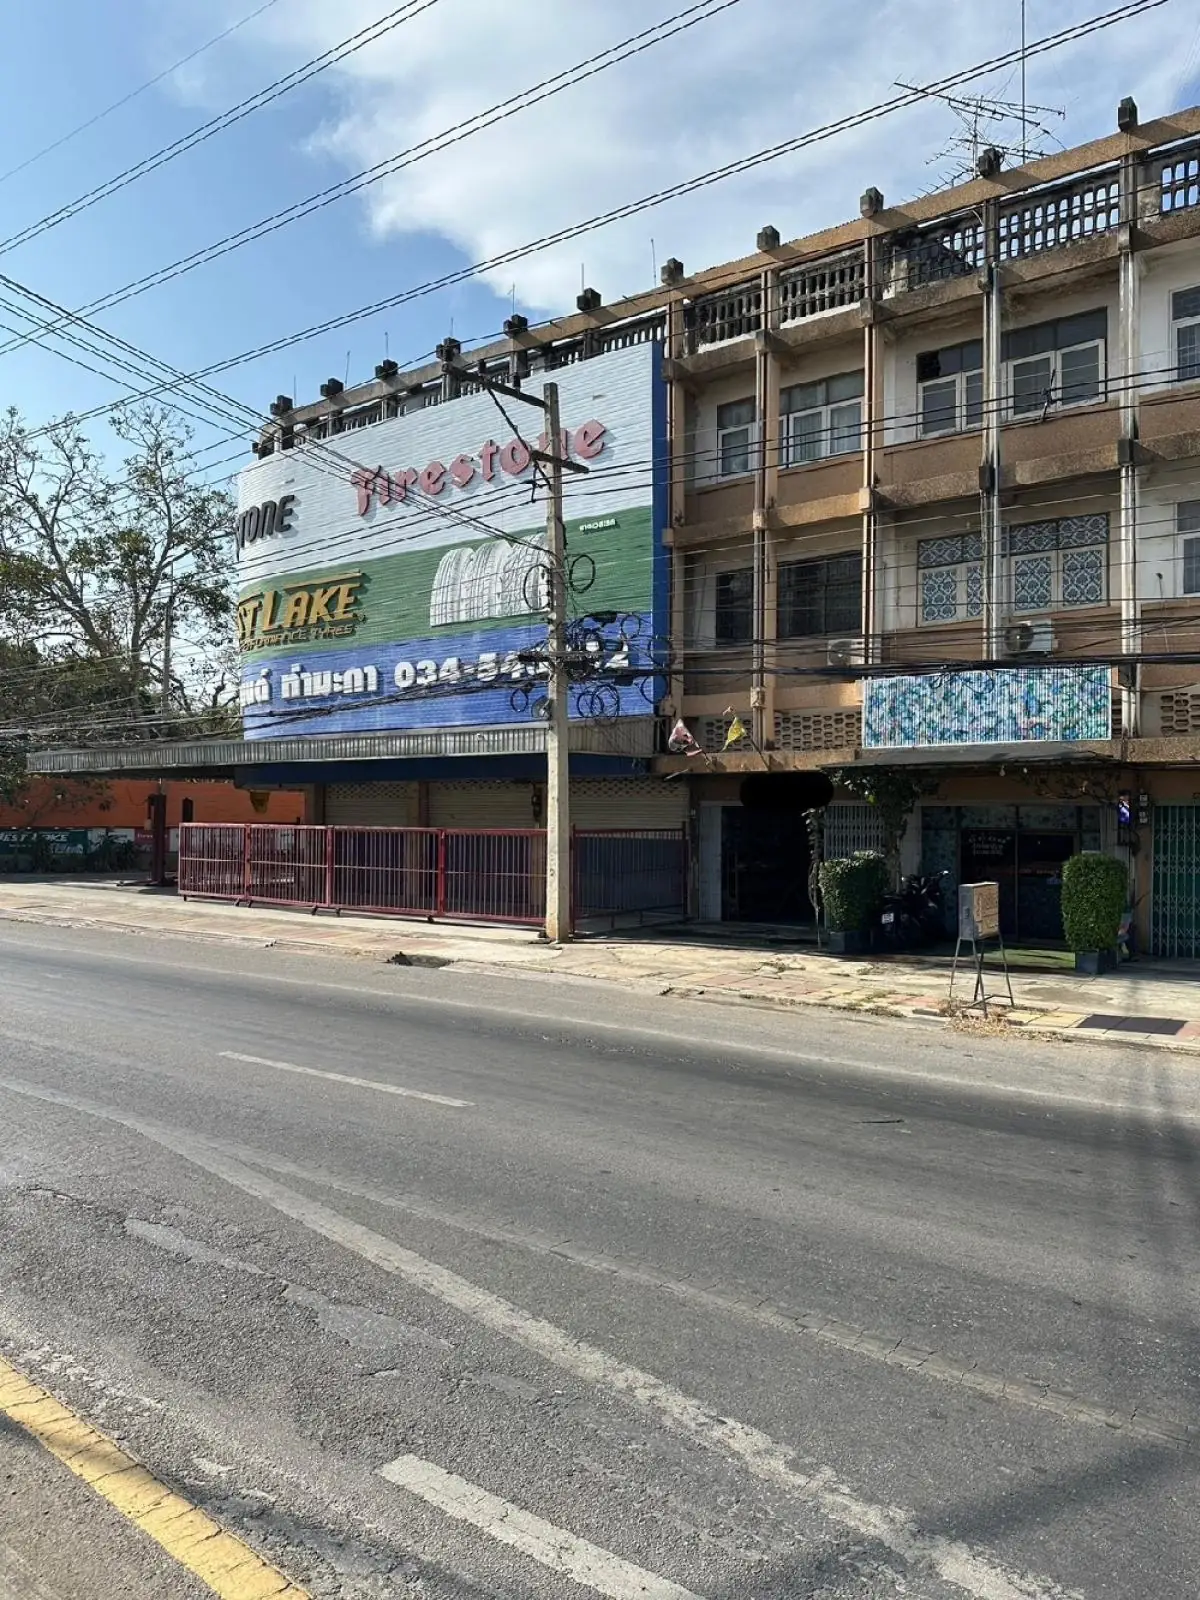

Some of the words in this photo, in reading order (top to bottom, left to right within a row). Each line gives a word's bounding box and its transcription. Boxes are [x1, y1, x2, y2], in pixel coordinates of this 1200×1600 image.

[352, 419, 605, 516] Firestone
[281, 663, 377, 699] ท่ามะกา
